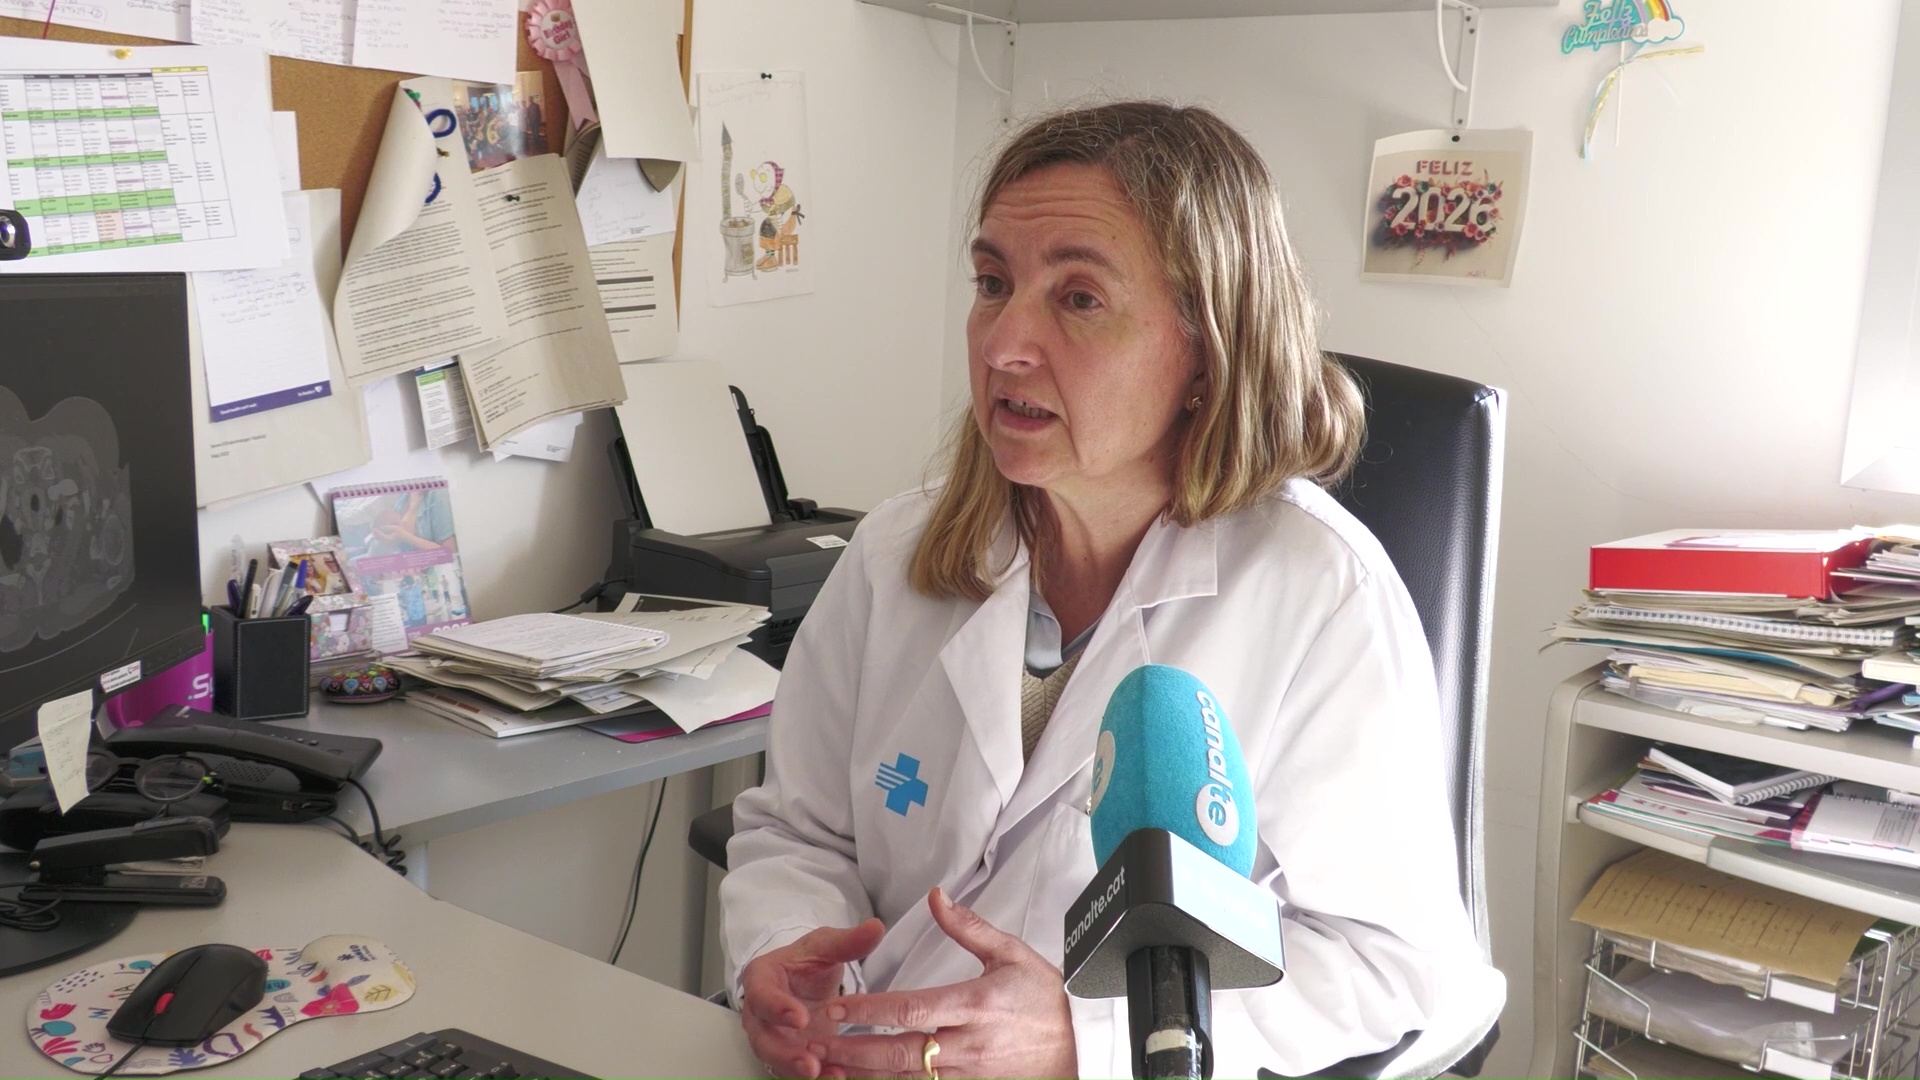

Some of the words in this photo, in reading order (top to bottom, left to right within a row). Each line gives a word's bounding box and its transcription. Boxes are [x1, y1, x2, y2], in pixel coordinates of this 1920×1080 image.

[553, 30, 571, 45] Girl
[1416, 159, 1473, 177] FELIZ
[1389, 187, 1497, 233] 2026
[1196, 690, 1236, 829] canalte
[1064, 864, 1126, 954] canalte.cat
